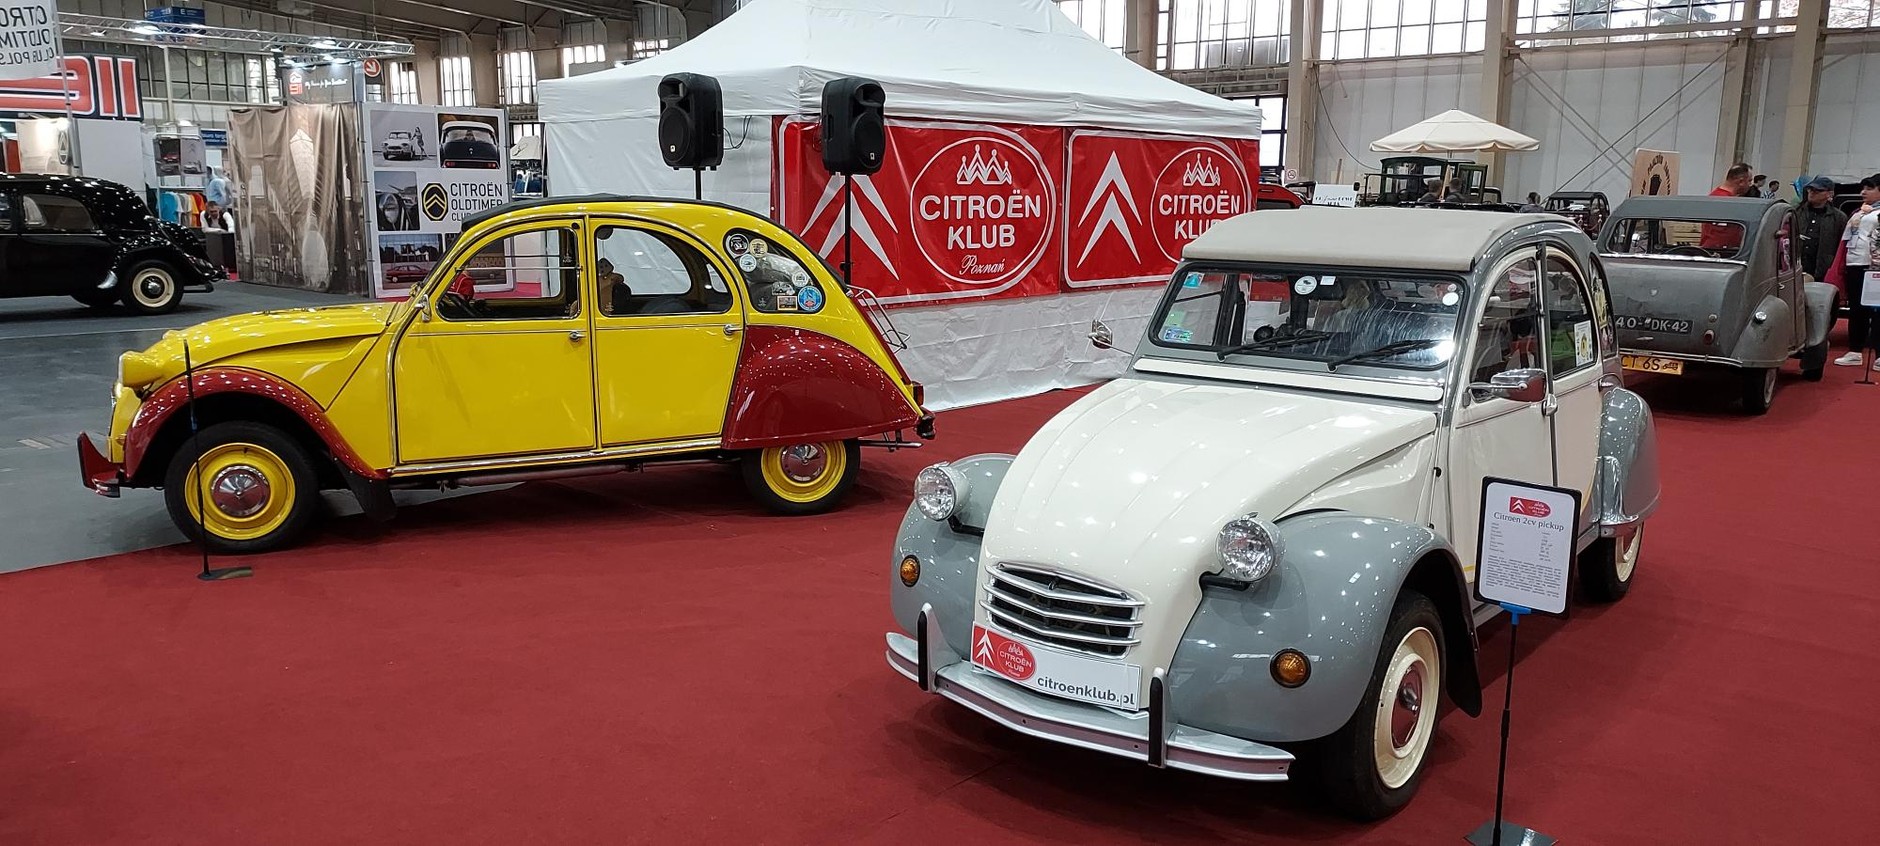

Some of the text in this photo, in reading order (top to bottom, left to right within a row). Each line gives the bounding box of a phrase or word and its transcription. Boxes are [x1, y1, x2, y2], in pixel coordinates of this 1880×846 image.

[450, 181, 503, 197] CITROËN
[920, 189, 1041, 220] CITROËN
[1159, 190, 1240, 215] CITROËN
[947, 224, 1016, 250] KLUB
[1174, 219, 1211, 240] KLU
[959, 254, 1006, 275] Poznań
[1493, 511, 1565, 533] Citroen 2cv pickup
[999, 650, 1032, 668] CITROËN
[1005, 660, 1025, 673] KLUB
[1037, 675, 1135, 707] citroenklub.pl
